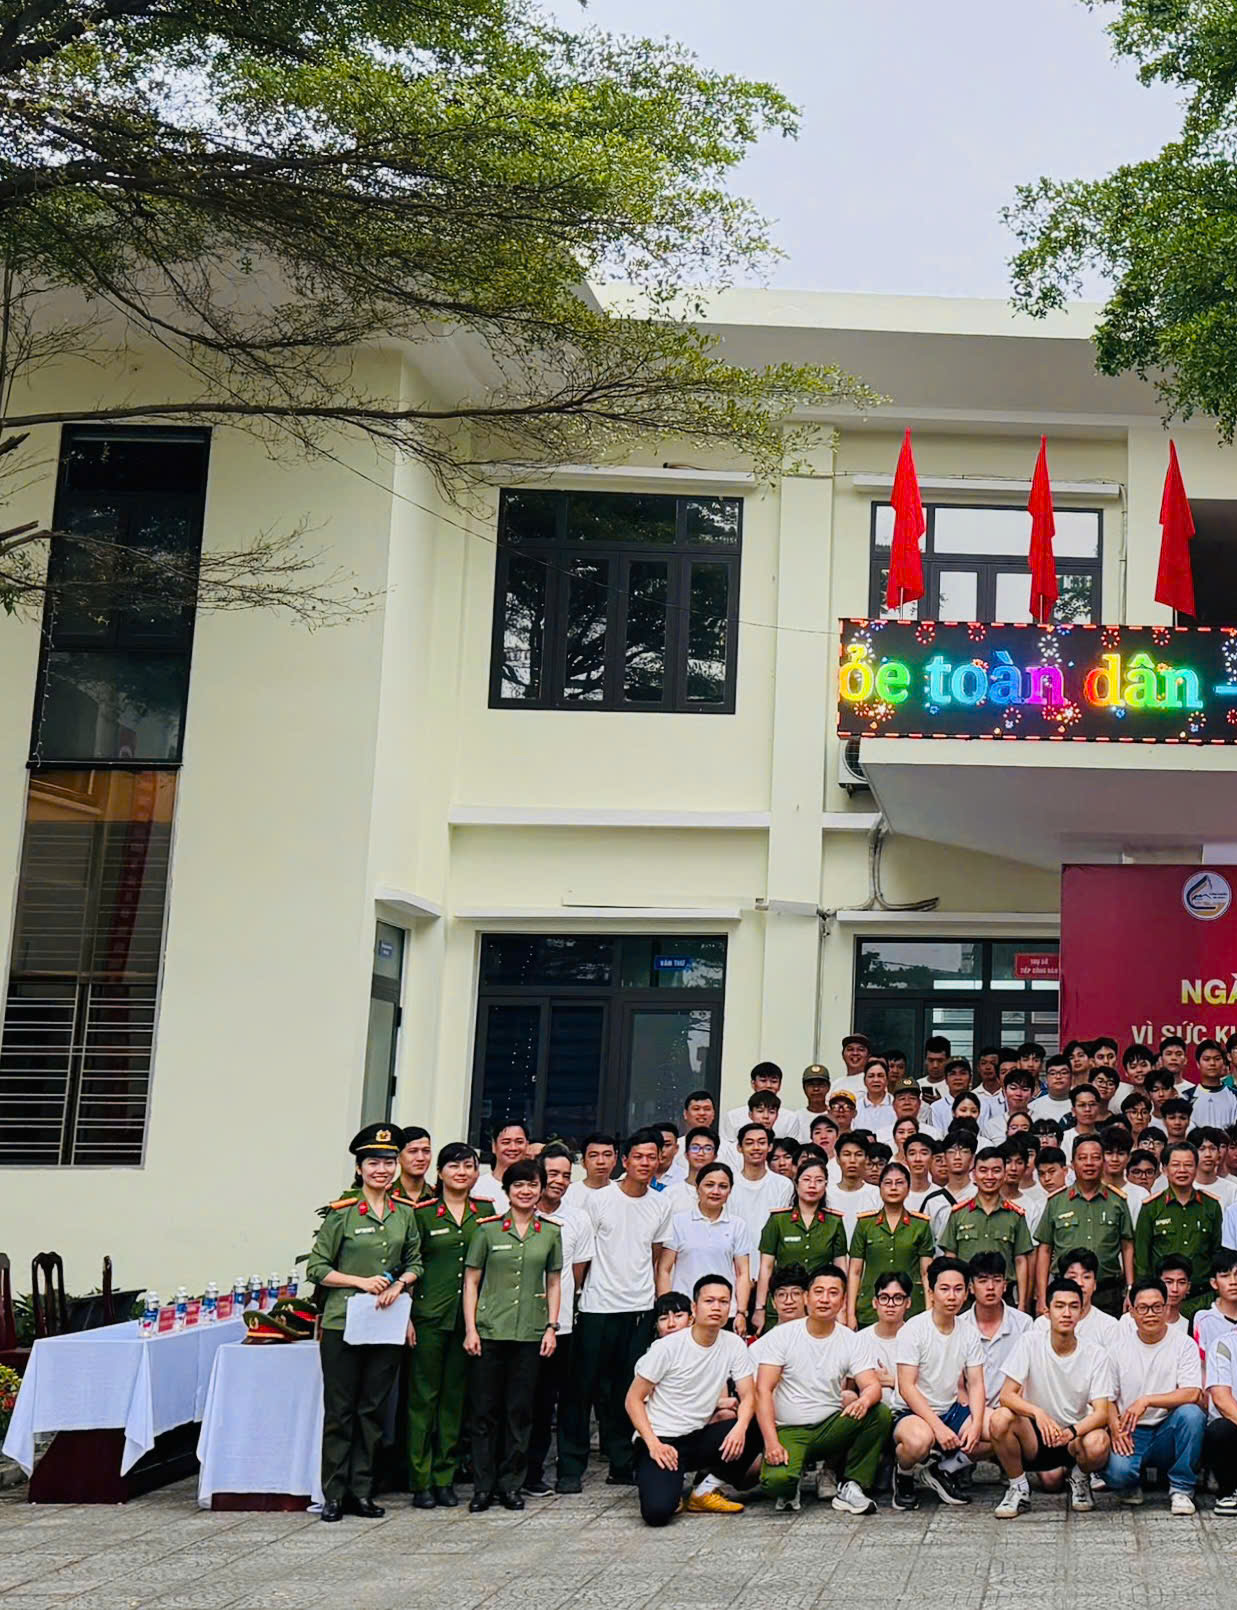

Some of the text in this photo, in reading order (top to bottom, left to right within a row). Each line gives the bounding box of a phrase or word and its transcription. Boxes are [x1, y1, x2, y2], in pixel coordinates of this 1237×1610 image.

[839, 643, 911, 702] ỏe
[925, 650, 1066, 706] toàn
[1084, 653, 1203, 708] dân
[1131, 1020, 1153, 1045] VÌ
